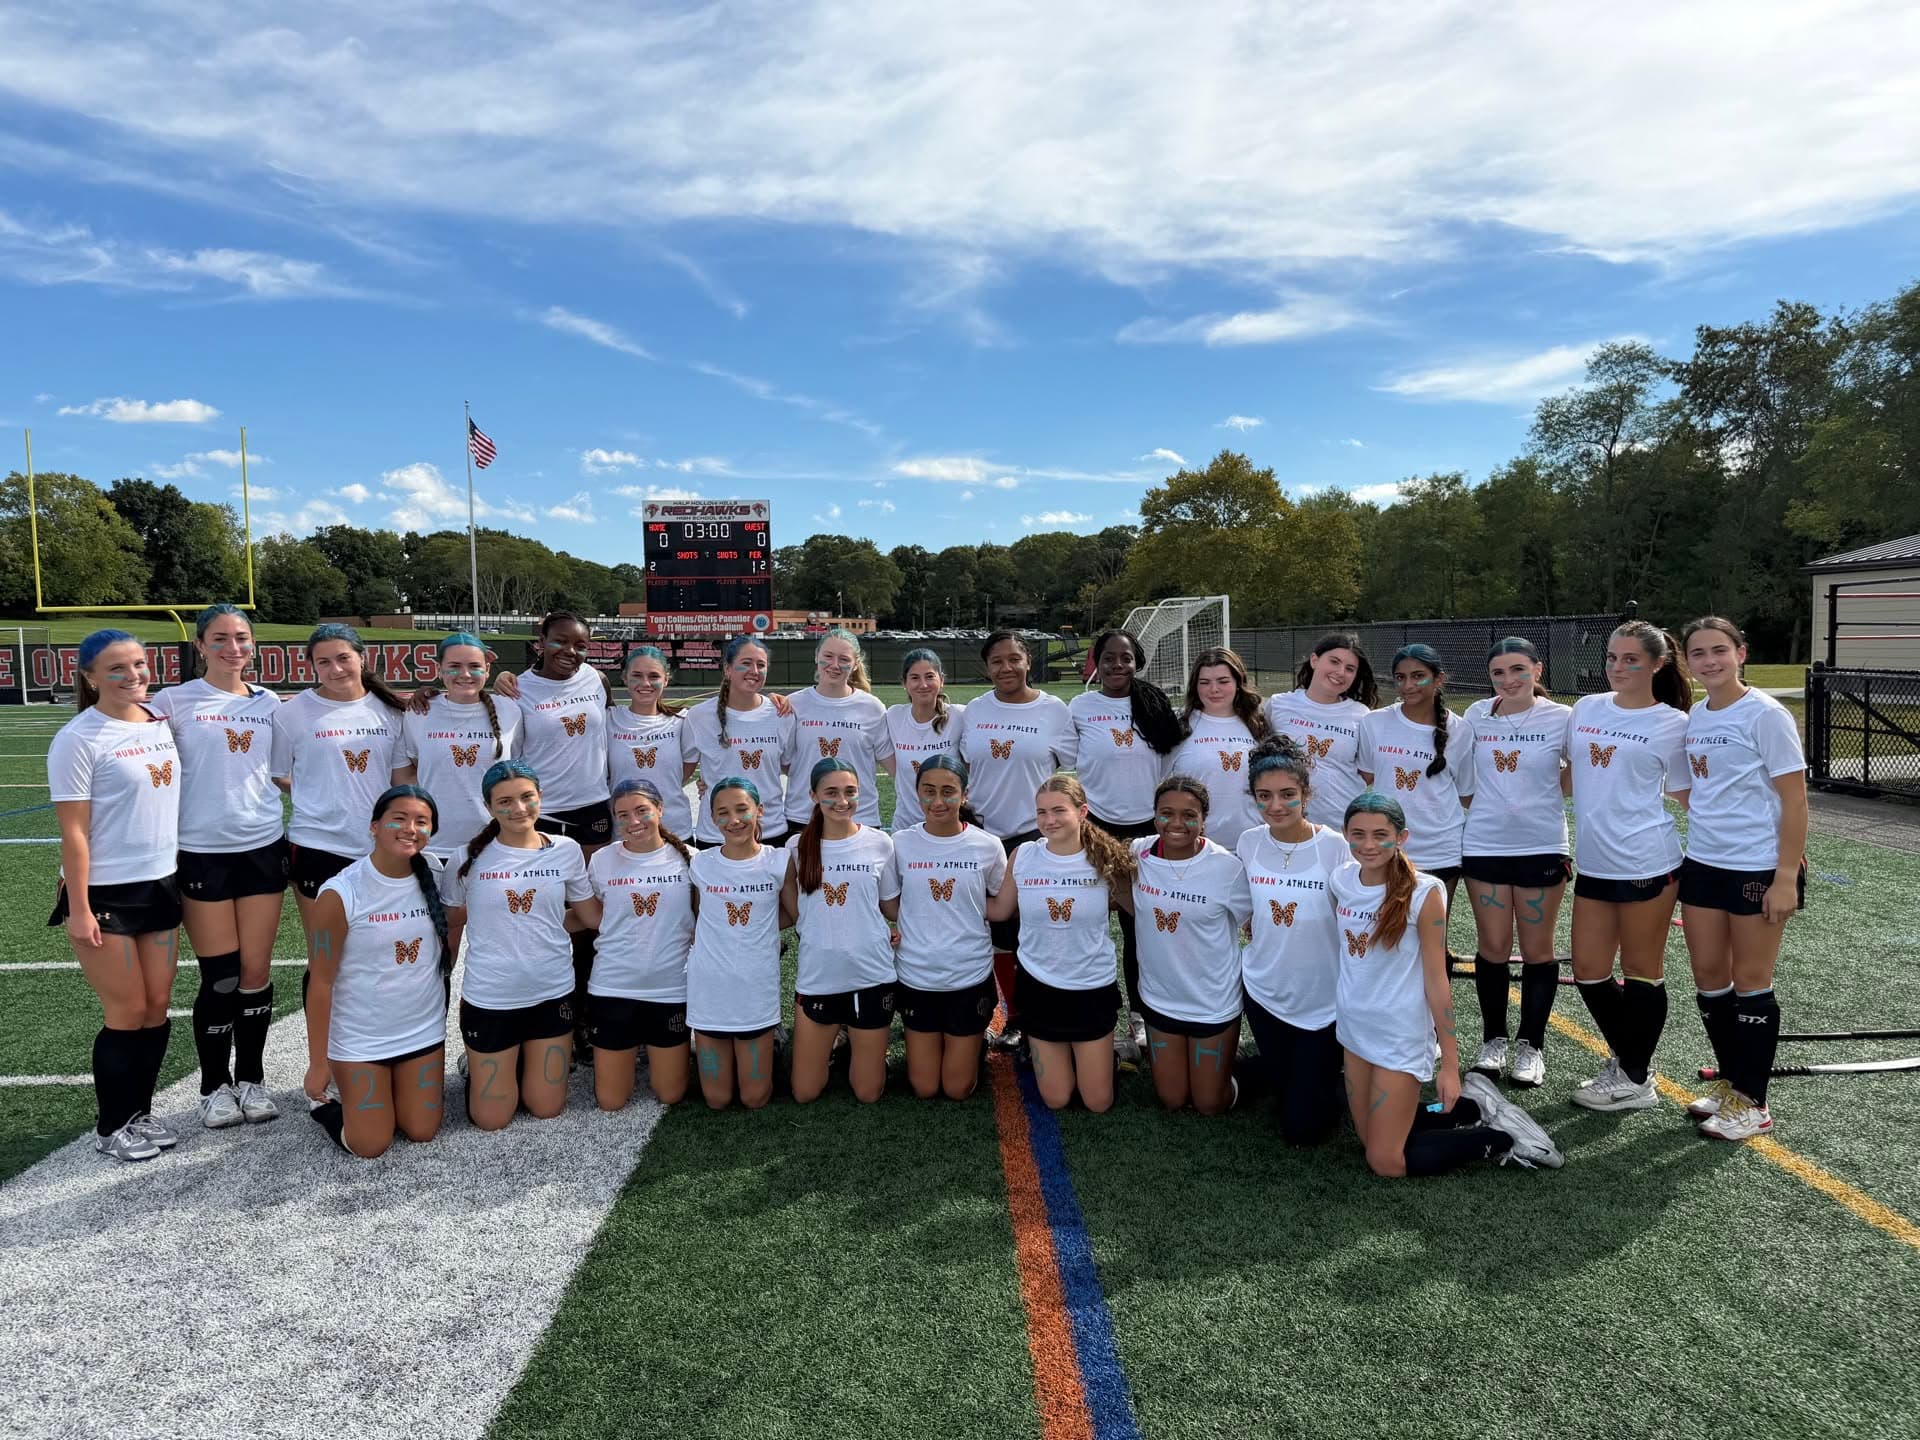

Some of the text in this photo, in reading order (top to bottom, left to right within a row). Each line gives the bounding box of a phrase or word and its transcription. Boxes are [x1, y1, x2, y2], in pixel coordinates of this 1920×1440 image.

[661, 505, 750, 516] REDHAWKS
[649, 524, 666, 532] HOME
[684, 524, 730, 538] 03:00
[744, 522, 766, 530] GUEST
[660, 532, 668, 548] 0
[757, 532, 766, 546] 0
[677, 551, 698, 560] SHOTS
[716, 551, 738, 560] SHOTS
[658, 623, 744, 632] 9/11 Memorial Stadium
[32, 648, 80, 686] OF
[534, 702, 562, 711] HUMAN
[570, 694, 600, 704] ATHLETE
[195, 714, 228, 722] HUMAN
[832, 720, 861, 730] ATHLETE
[1007, 725, 1038, 734] ATHLETE
[1289, 718, 1316, 728] HUMAN
[1324, 724, 1356, 738] ATHLETE
[315, 729, 345, 739] HUMAN
[356, 728, 388, 736] ATHLETE
[428, 732, 456, 740] HUMAN
[613, 733, 637, 741] HUMAN
[646, 732, 675, 742] ATHLETE
[1508, 734, 1546, 742] ATHLETE
[1577, 725, 1601, 735] HUMAN
[1611, 731, 1649, 745] ATHLETE
[751, 736, 777, 744] ATHLETE
[1194, 737, 1219, 745] HUMAN
[1700, 736, 1728, 745] ATHLETE
[114, 746, 146, 759] HUMAN
[154, 741, 176, 752] ATHLE
[896, 743, 914, 751] HUMAN
[923, 740, 952, 750] ATHLETE
[1378, 746, 1404, 755] HUMAN
[1413, 752, 1434, 761] ATHL
[836, 864, 870, 872] ATHLETE
[908, 862, 934, 870] HUMAN
[944, 862, 978, 870] ATHLETE
[480, 872, 510, 880] HUMAN
[523, 869, 560, 878] ATHLETE
[608, 878, 635, 887] HUMAN
[646, 874, 682, 884] ATHLETE
[1024, 878, 1050, 886] HUMAN
[1250, 876, 1276, 886] HUMAN
[1286, 879, 1324, 890] ATHLETE
[740, 882, 774, 892] ATHLETE
[1171, 891, 1207, 904] ATHLETE
[368, 912, 400, 922] HUMAN
[410, 907, 430, 919] ATHL
[243, 1002, 271, 1016] STX
[1738, 1014, 1768, 1024] STX
